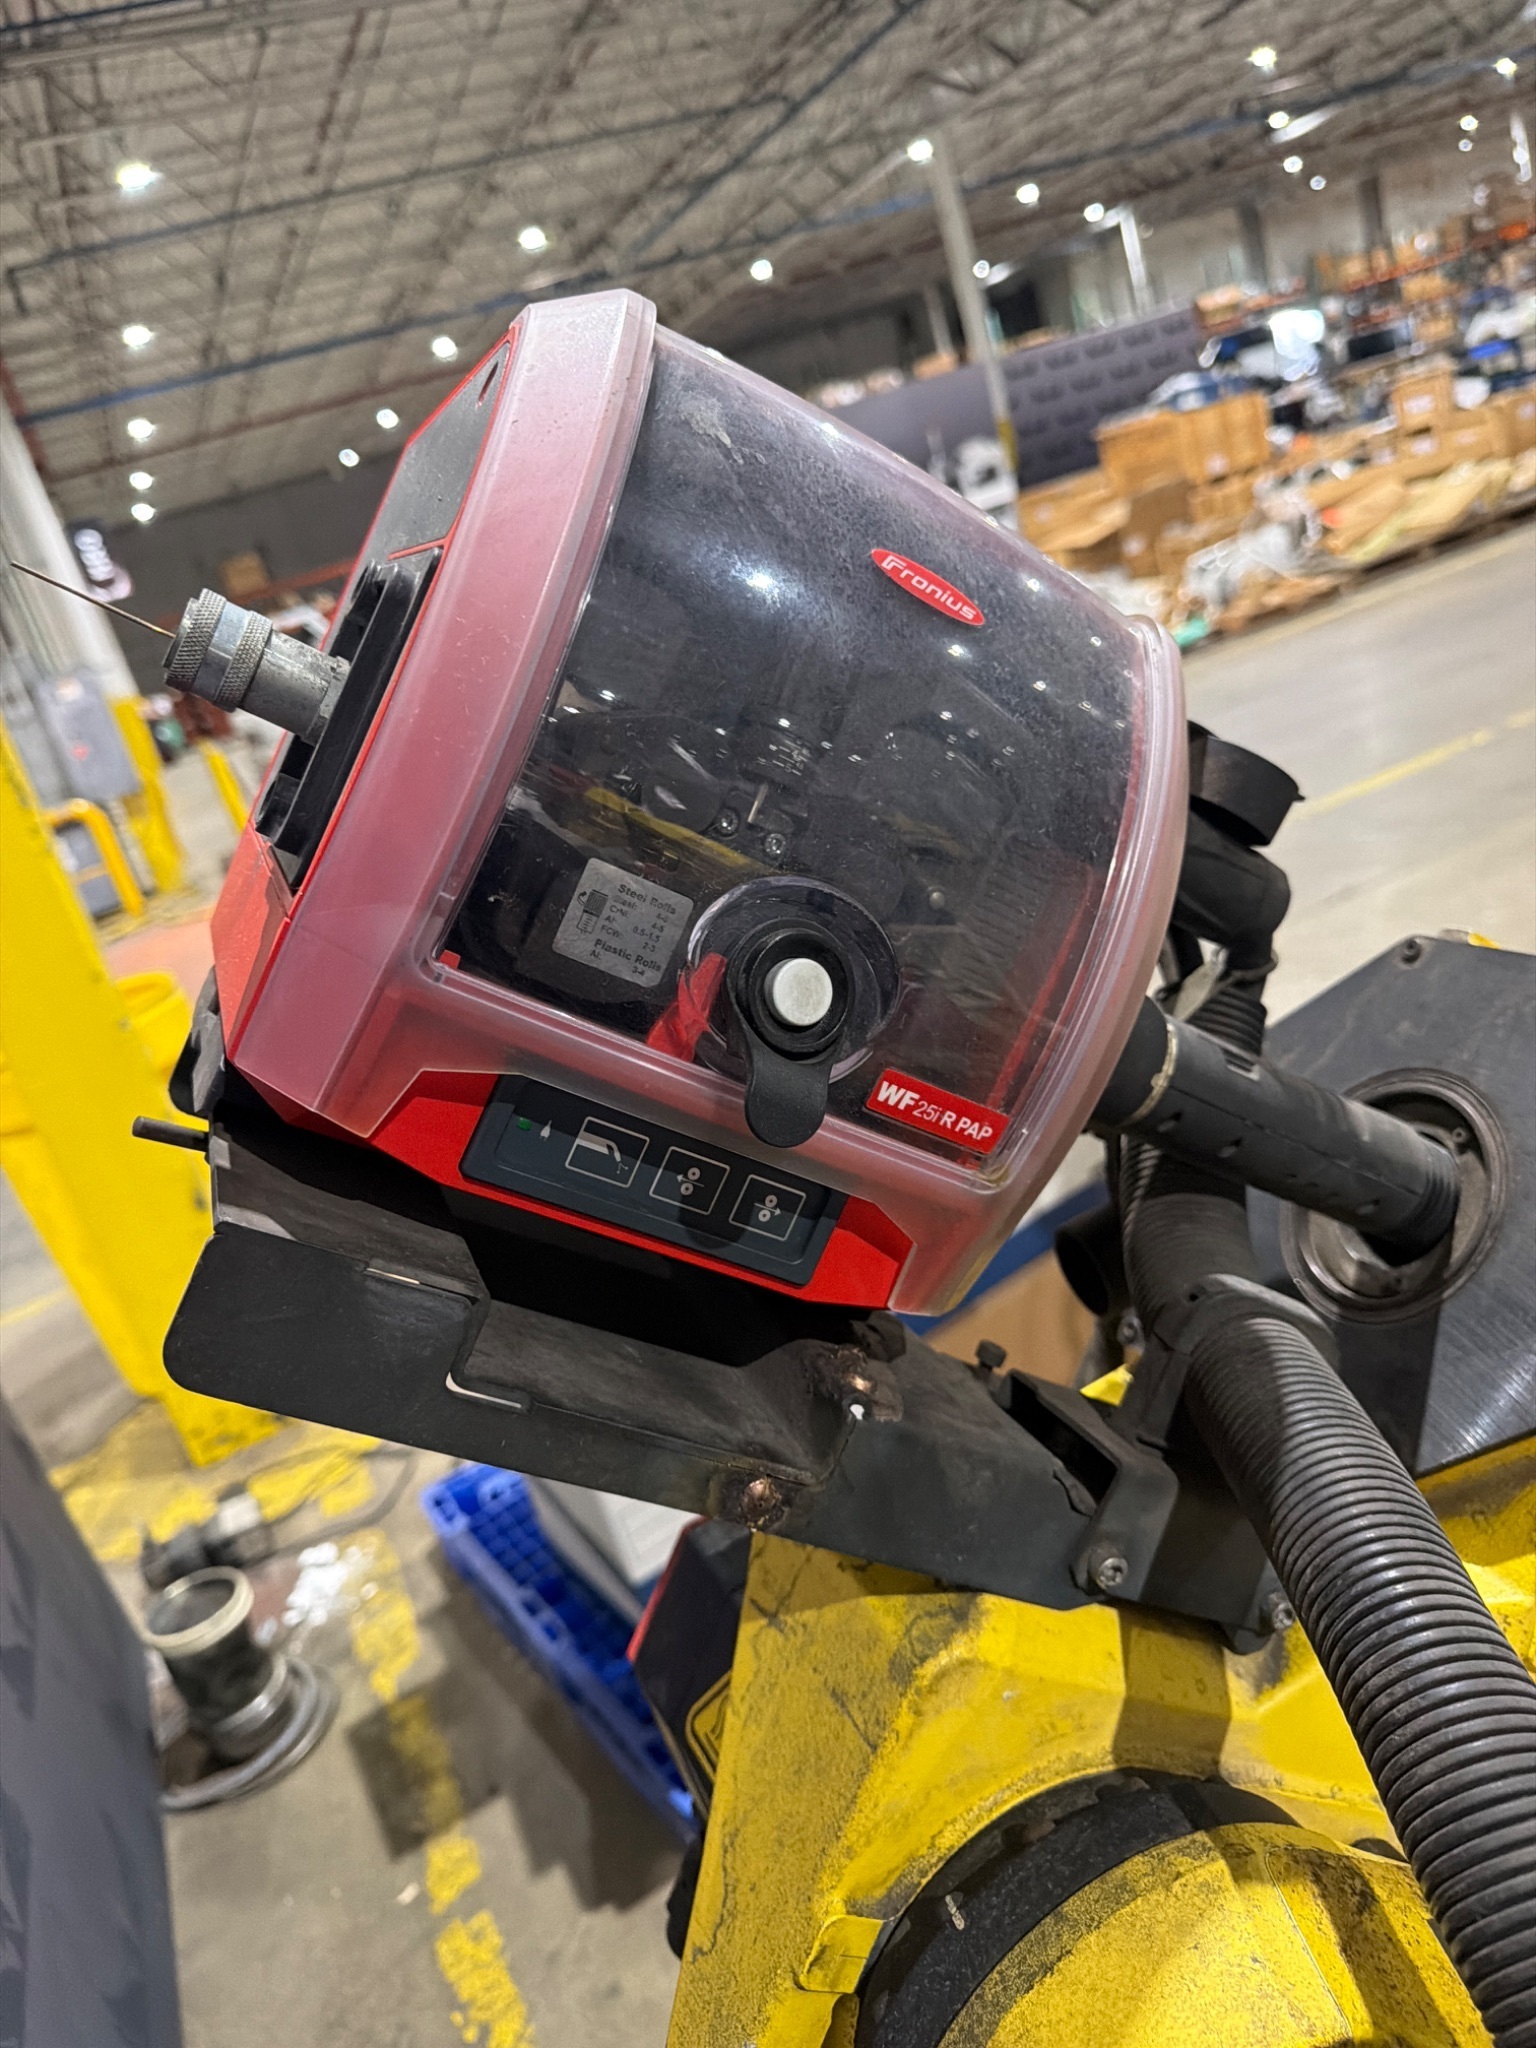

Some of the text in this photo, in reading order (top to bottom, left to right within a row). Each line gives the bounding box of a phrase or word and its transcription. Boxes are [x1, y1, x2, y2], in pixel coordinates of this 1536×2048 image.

[881, 555, 976, 620] Fronius
[618, 884, 647, 902] Steel
[594, 938, 662, 971] Plastic Rolls
[877, 1081, 920, 1110] WF
[954, 1116, 993, 1141] PAP
